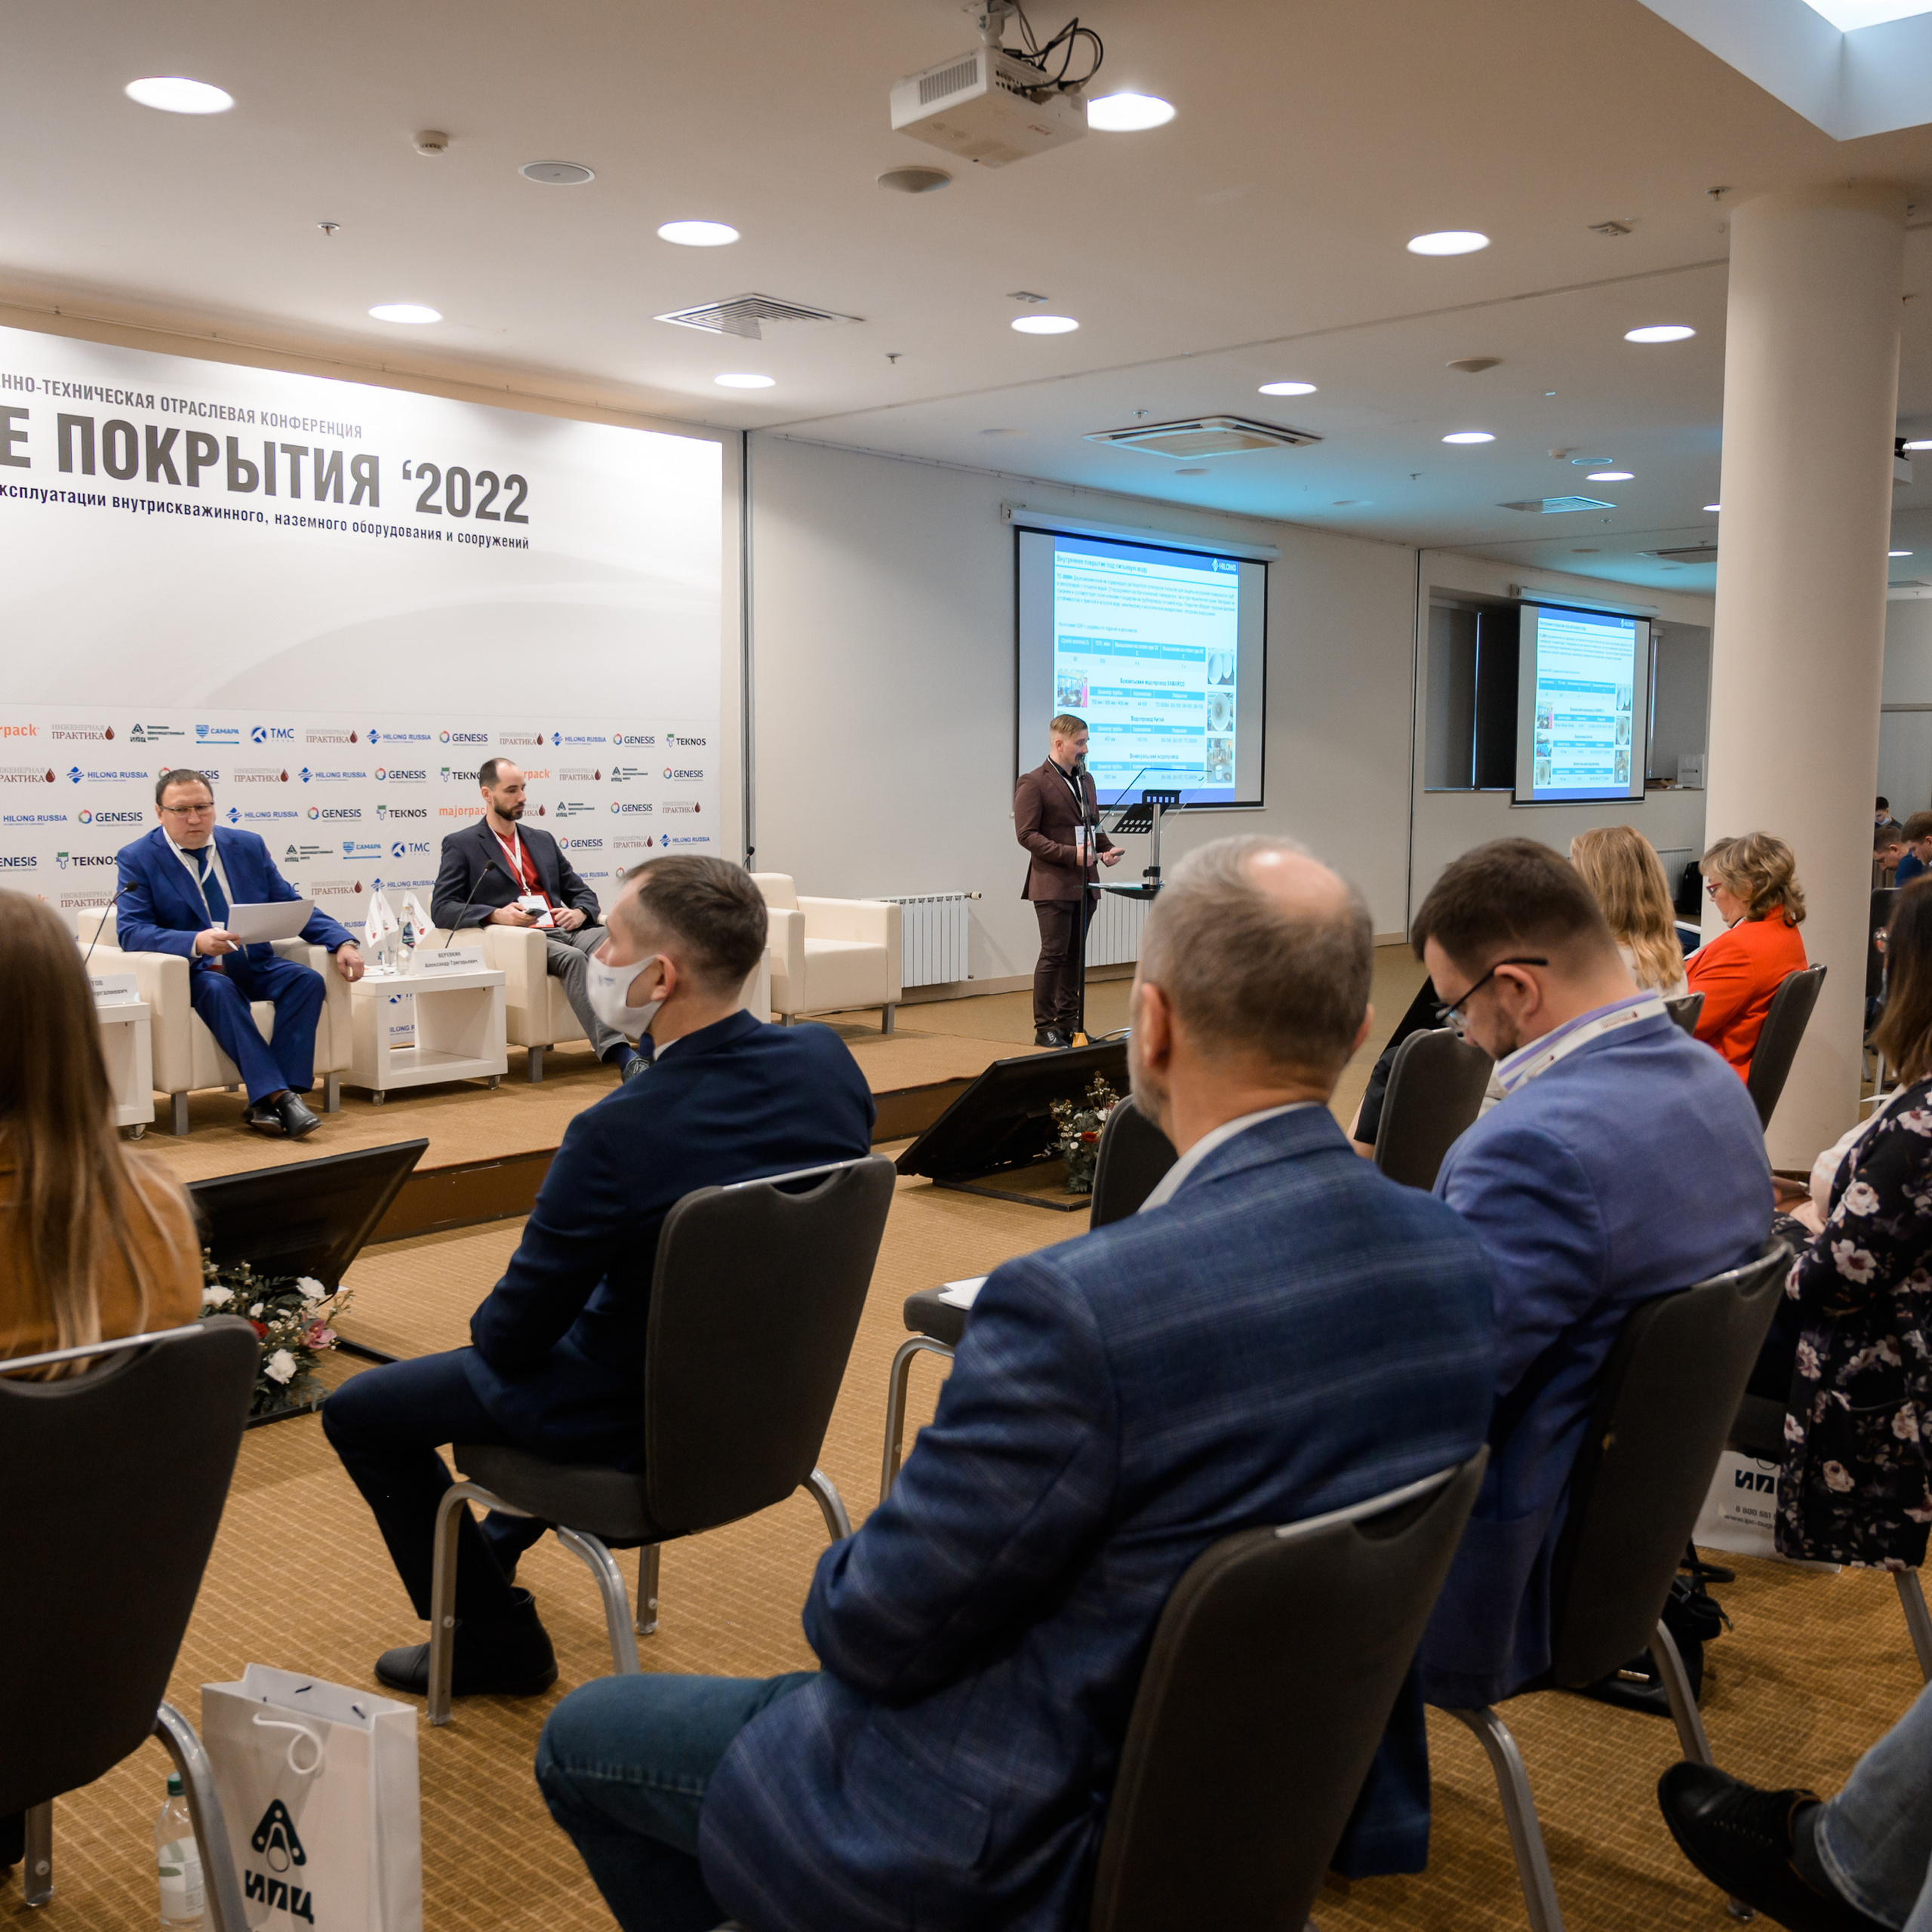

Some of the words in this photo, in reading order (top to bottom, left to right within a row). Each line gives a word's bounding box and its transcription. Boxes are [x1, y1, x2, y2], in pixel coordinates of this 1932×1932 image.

[161, 396, 255, 424] ОТРАСЛЕВАЯ
[261, 411, 361, 439] КОНФЕРЕНЦИЯ
[57, 412, 380, 509] ПОКРЫТИЯ
[0, 484, 106, 507] ксплуатации
[113, 495, 269, 525] внутрискважинного,
[275, 513, 347, 531] наземного
[352, 520, 441, 541] оборудования
[447, 531, 453, 543] и
[457, 531, 529, 549] сооружений
[52, 731, 105, 740] ПРАКТИКА
[453, 734, 488, 743] GENESIS
[624, 736, 655, 744] GENESIS
[676, 737, 706, 746] TEKNOS
[234, 774, 281, 783] ПРАКТИКА
[389, 771, 426, 780] GENESIS
[452, 771, 481, 780] TEKN
[524, 768, 549, 780] rpack
[674, 770, 703, 778] GENESIS
[322, 808, 361, 818] GENESIS
[622, 804, 653, 813] GENESIS
[95, 811, 143, 822] GENESIS
[389, 809, 427, 818] TEKNOS
[571, 838, 603, 848] GENESIS
[311, 888, 354, 896] ПРАКТИКА
[60, 898, 112, 908] ПРАКТИКА
[1735, 1469, 1775, 1494] ИП
[1743, 1507, 1757, 1516] 800
[1759, 1510, 1771, 1519] 551
